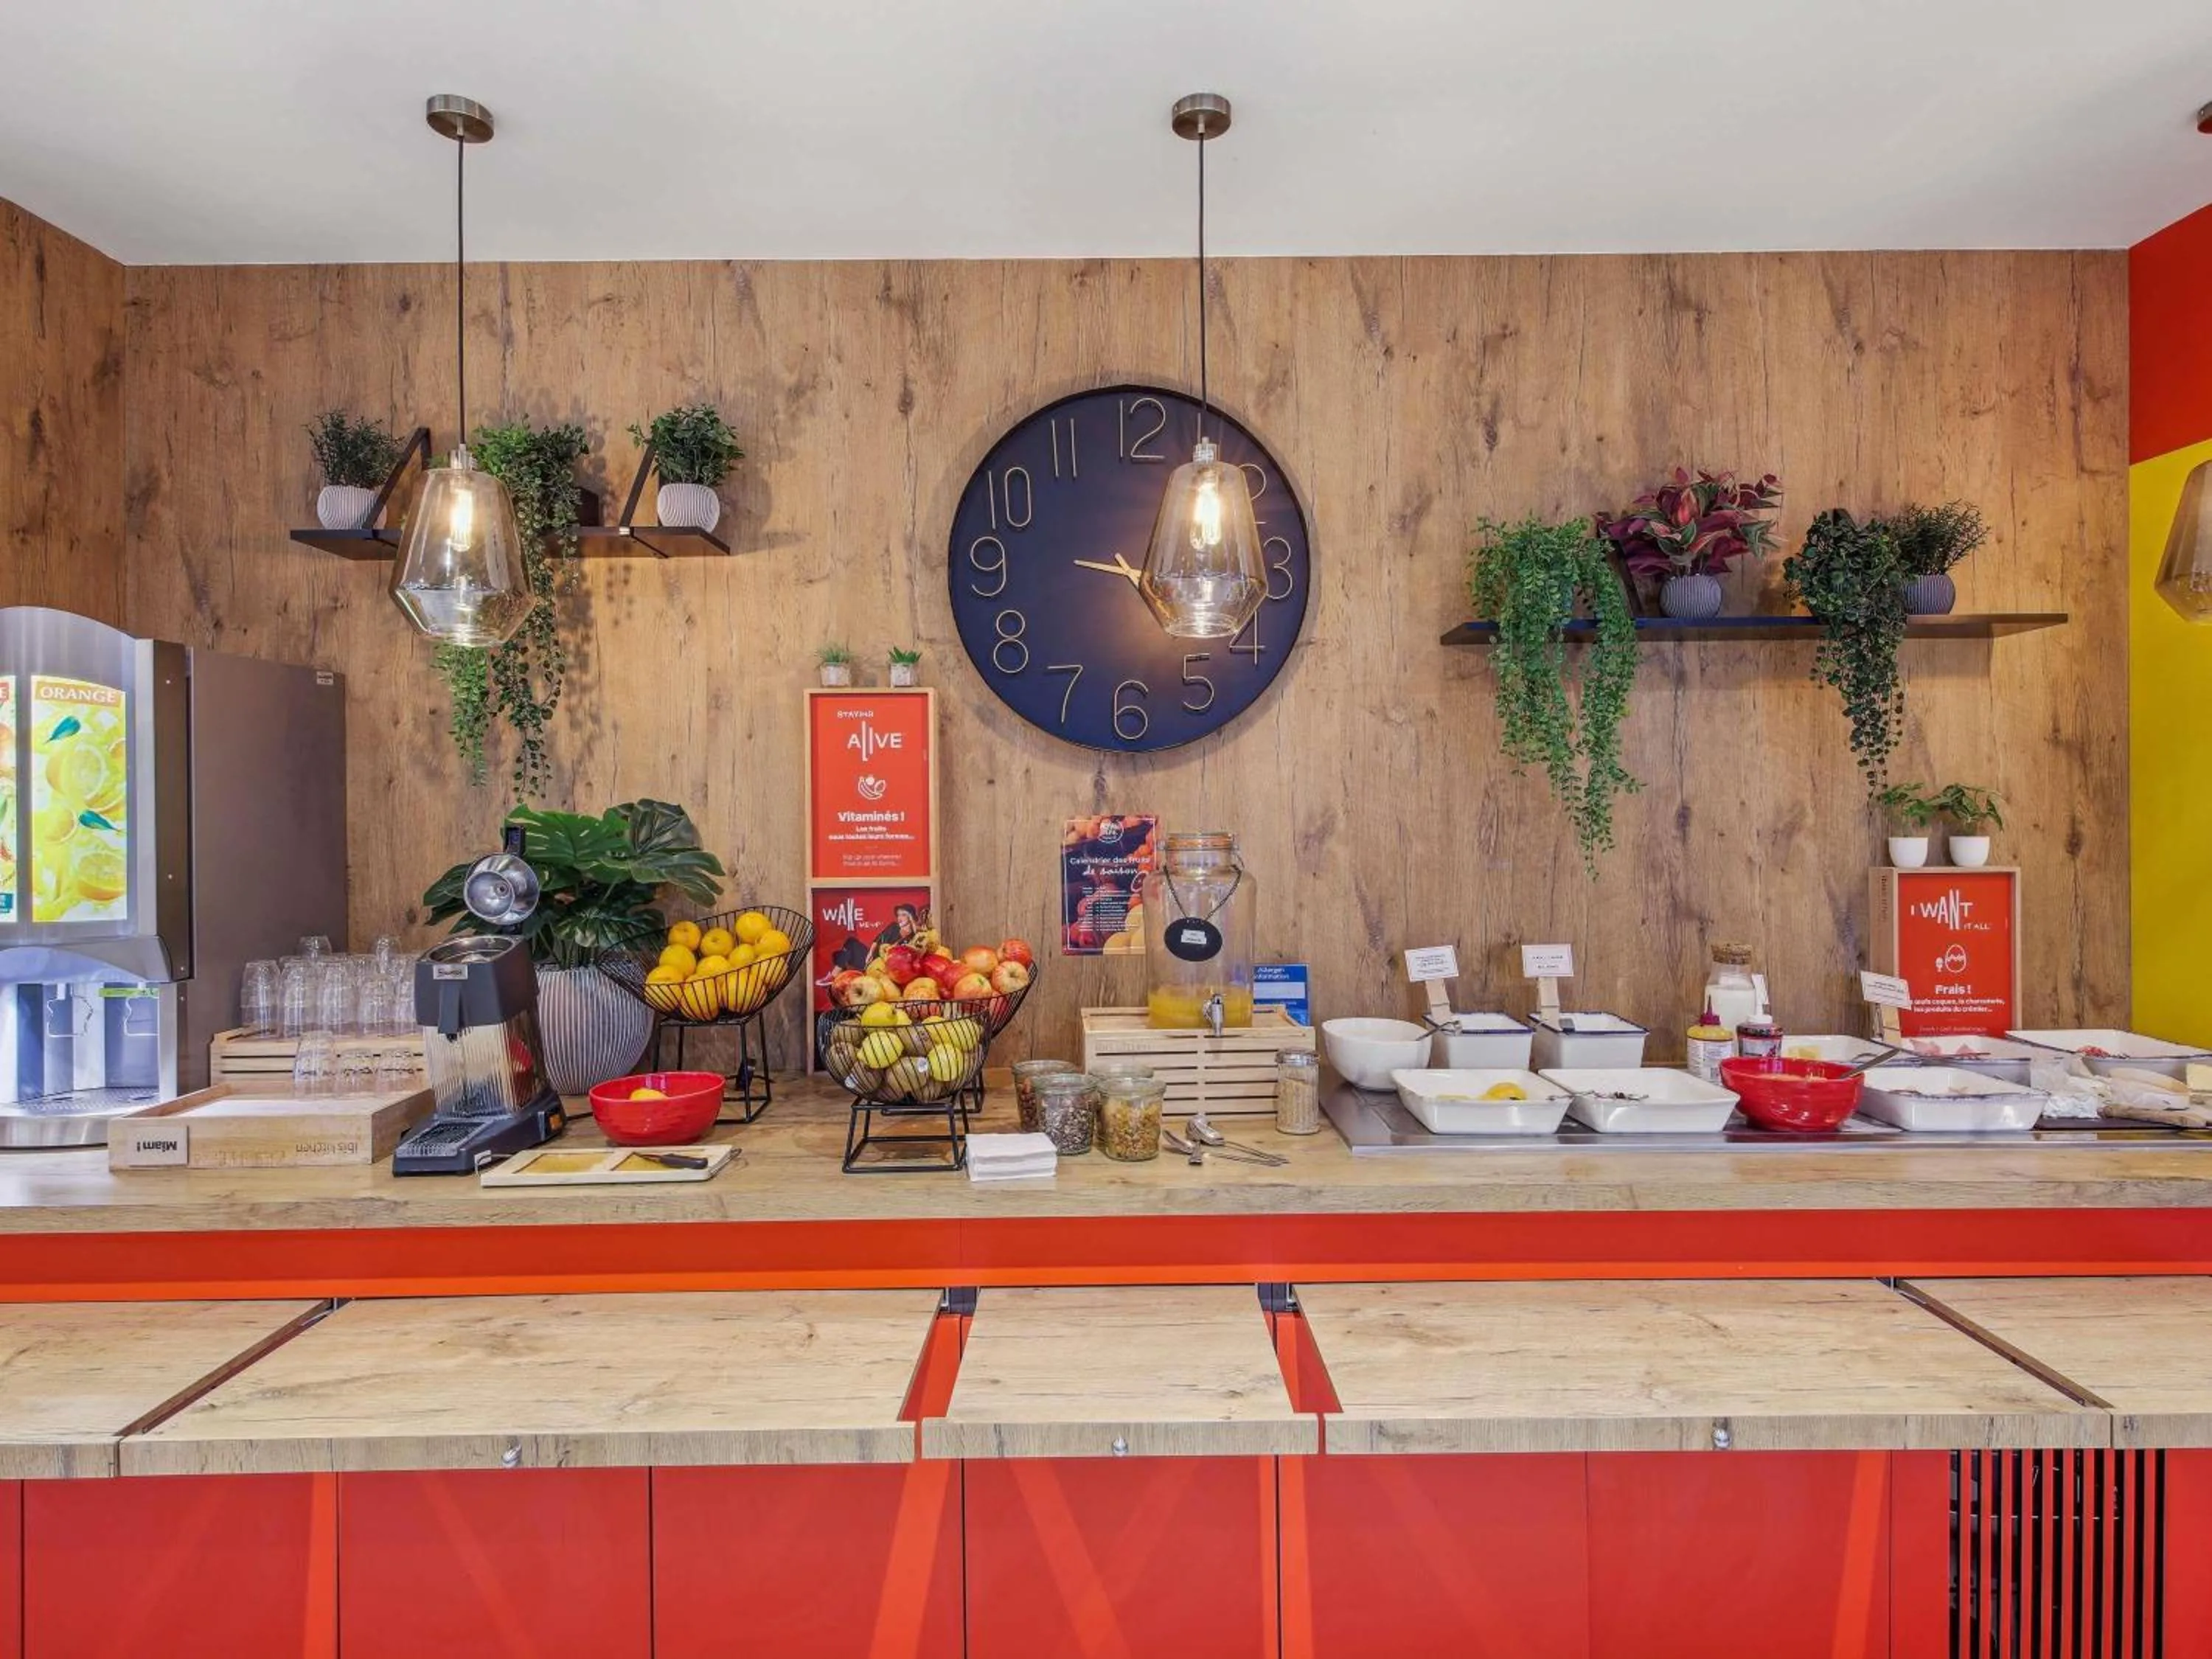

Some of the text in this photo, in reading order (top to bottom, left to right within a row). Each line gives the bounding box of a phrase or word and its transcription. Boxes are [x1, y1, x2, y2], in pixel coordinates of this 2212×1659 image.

[1051, 417, 1077, 478] 11
[1119, 397, 1166, 461] 12
[987, 467, 1032, 530] 10
[970, 536, 1006, 597] 9
[1262, 536, 1293, 600] 3
[993, 610, 1029, 674] 8
[1228, 608, 1266, 665] 4
[40, 686, 116, 703] ORANGE
[1047, 664, 1083, 723] 7
[1114, 680, 1149, 740] 6
[1183, 653, 1214, 711] 5
[838, 810, 899, 822] Vitaminés
[822, 897, 864, 931] WAKE
[1910, 904, 1915, 916] I
[1919, 888, 1974, 931] WANT
[1935, 984, 1966, 995] Frais
[143, 1141, 178, 1152] Miam
